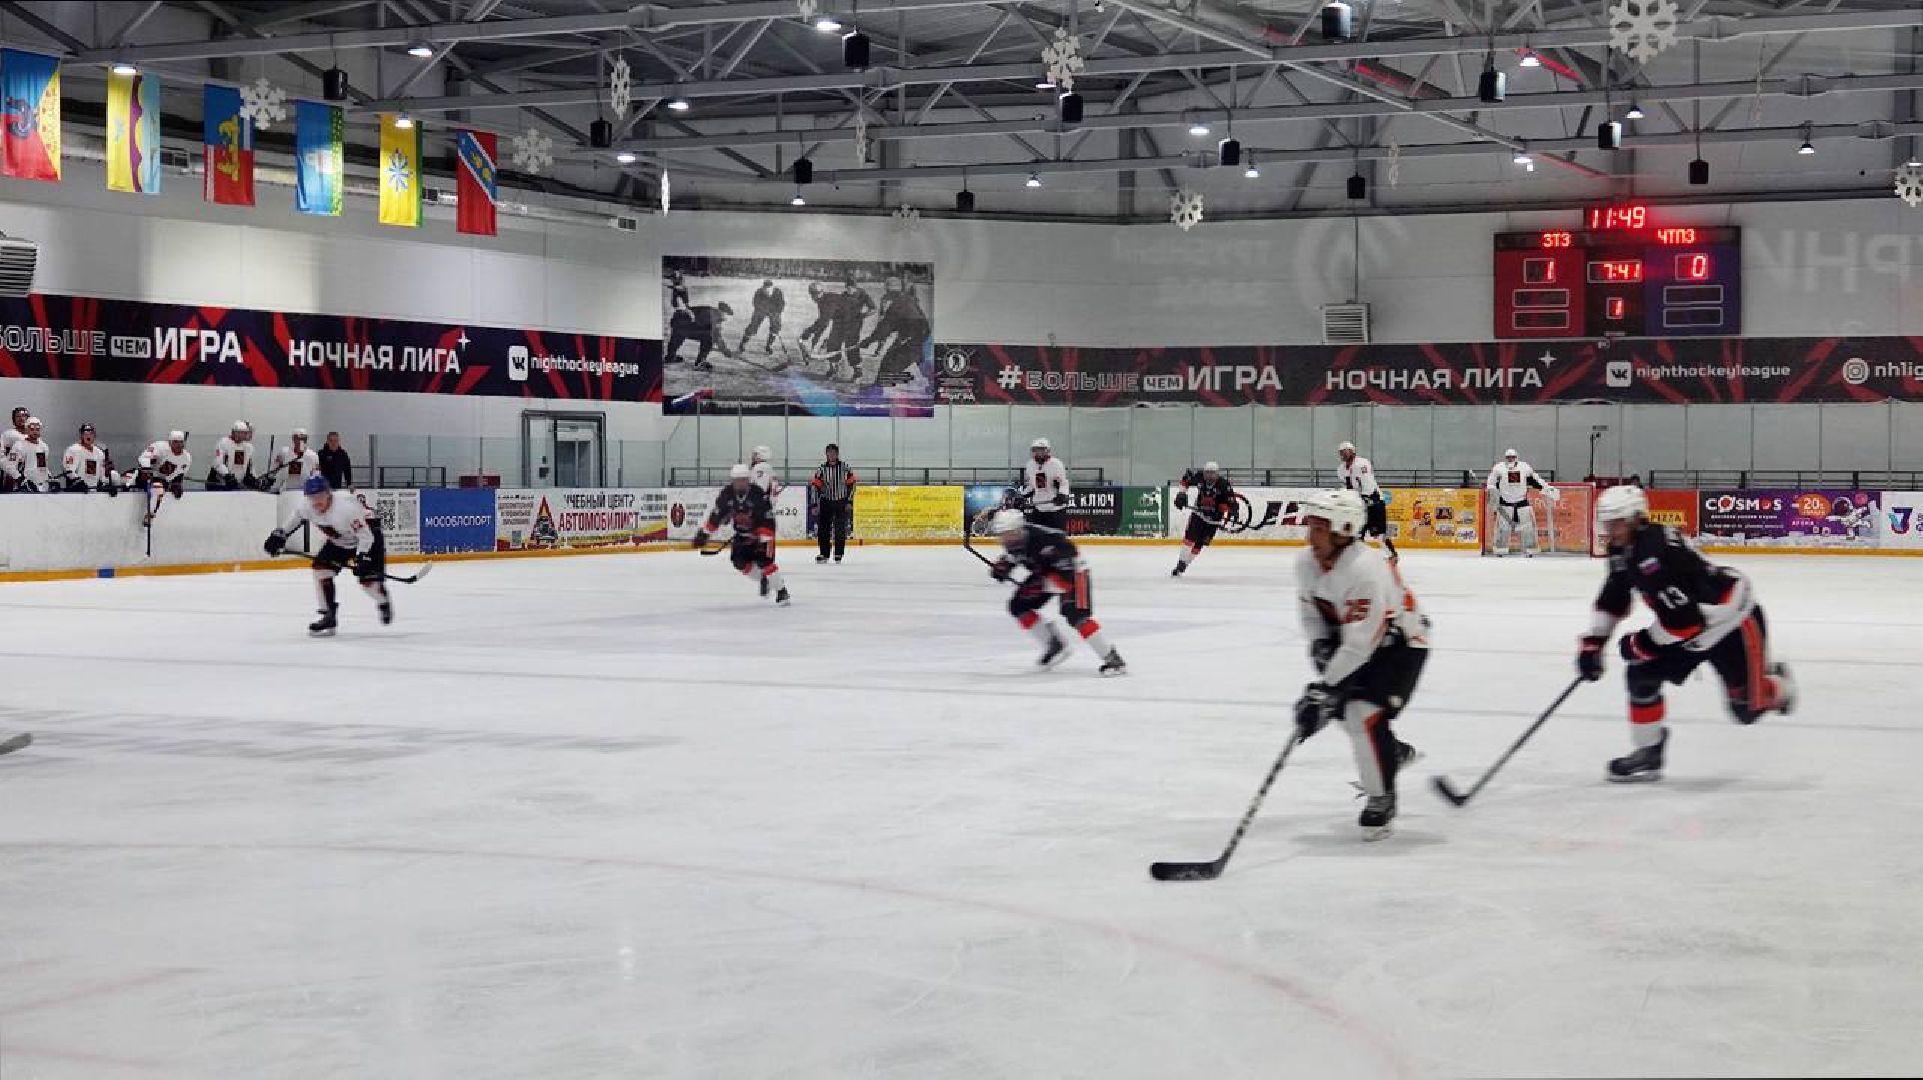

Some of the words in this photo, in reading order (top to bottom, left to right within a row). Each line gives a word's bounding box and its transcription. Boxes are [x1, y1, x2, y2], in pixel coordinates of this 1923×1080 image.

[1592, 206, 1646, 229] 11:49
[1545, 261, 1555, 280] 1
[1603, 263, 1640, 280] 7:41
[1692, 254, 1707, 278] 0
[1615, 300, 1624, 317] 1
[0, 324, 107, 356] ОЛЬШЕ
[114, 337, 148, 356] ЧЕМ
[155, 326, 244, 363] ИГРА
[289, 339, 393, 370] НОЧНАЯ
[400, 346, 461, 375] ЛИГА
[530, 353, 639, 378] nighthockeyleague
[1146, 377, 1181, 389] ЧЕМ
[1188, 365, 1283, 391] ИГРА
[1326, 369, 1451, 390] НОЧНАЯ
[1460, 368, 1542, 388] ЛИГА
[1636, 365, 1791, 381] nighthockeyleague
[1658, 586, 1689, 610] 13
